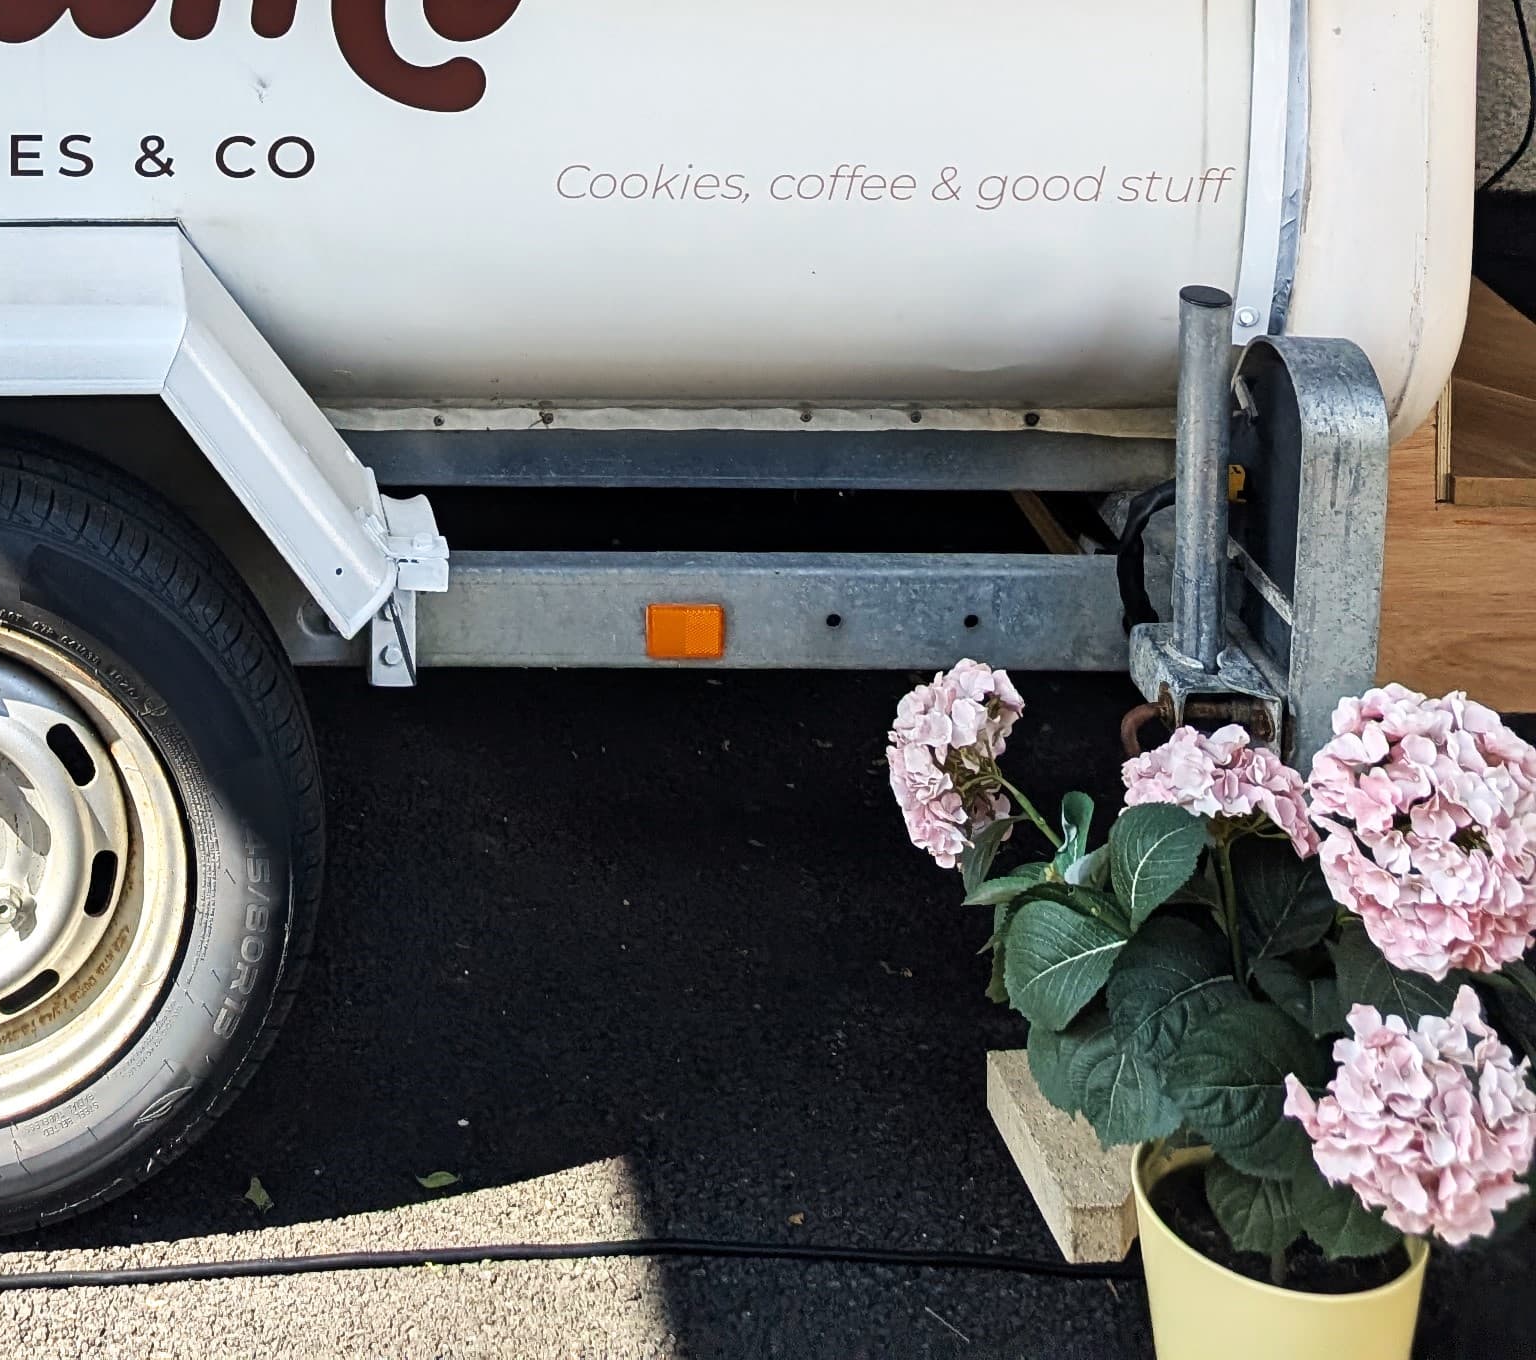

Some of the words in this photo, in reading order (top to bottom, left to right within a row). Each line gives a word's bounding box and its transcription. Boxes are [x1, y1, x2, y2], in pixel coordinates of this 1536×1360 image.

[135, 134, 177, 178] &
[215, 135, 316, 179] CO
[556, 163, 750, 205] Cookies,
[769, 163, 918, 202] coffee
[931, 166, 962, 202] &
[976, 165, 1107, 211] good
[1117, 166, 1237, 204] stuff
[213, 826, 272, 1040] 45/80R13
